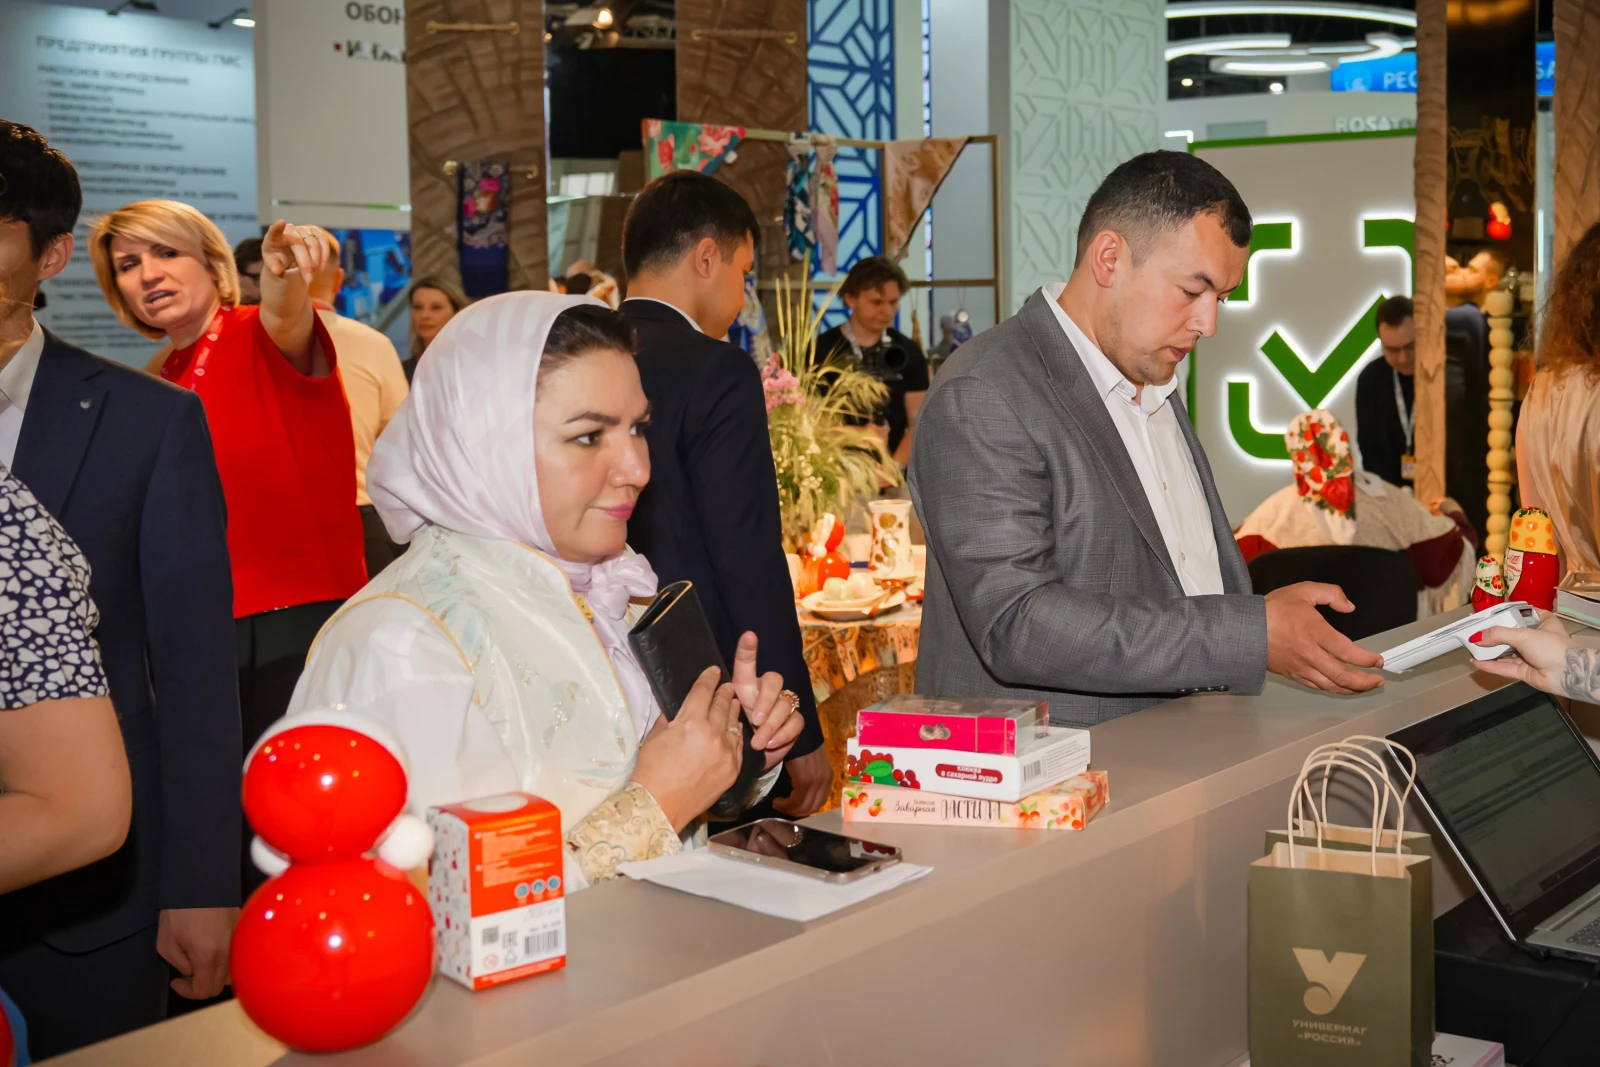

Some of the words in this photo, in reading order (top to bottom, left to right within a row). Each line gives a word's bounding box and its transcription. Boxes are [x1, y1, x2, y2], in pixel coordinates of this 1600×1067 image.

[895, 799, 936, 817] Заварная
[1292, 1019, 1368, 1035] УНИВЕРМАГ
[1297, 1032, 1362, 1046] «РОССИЯ»
